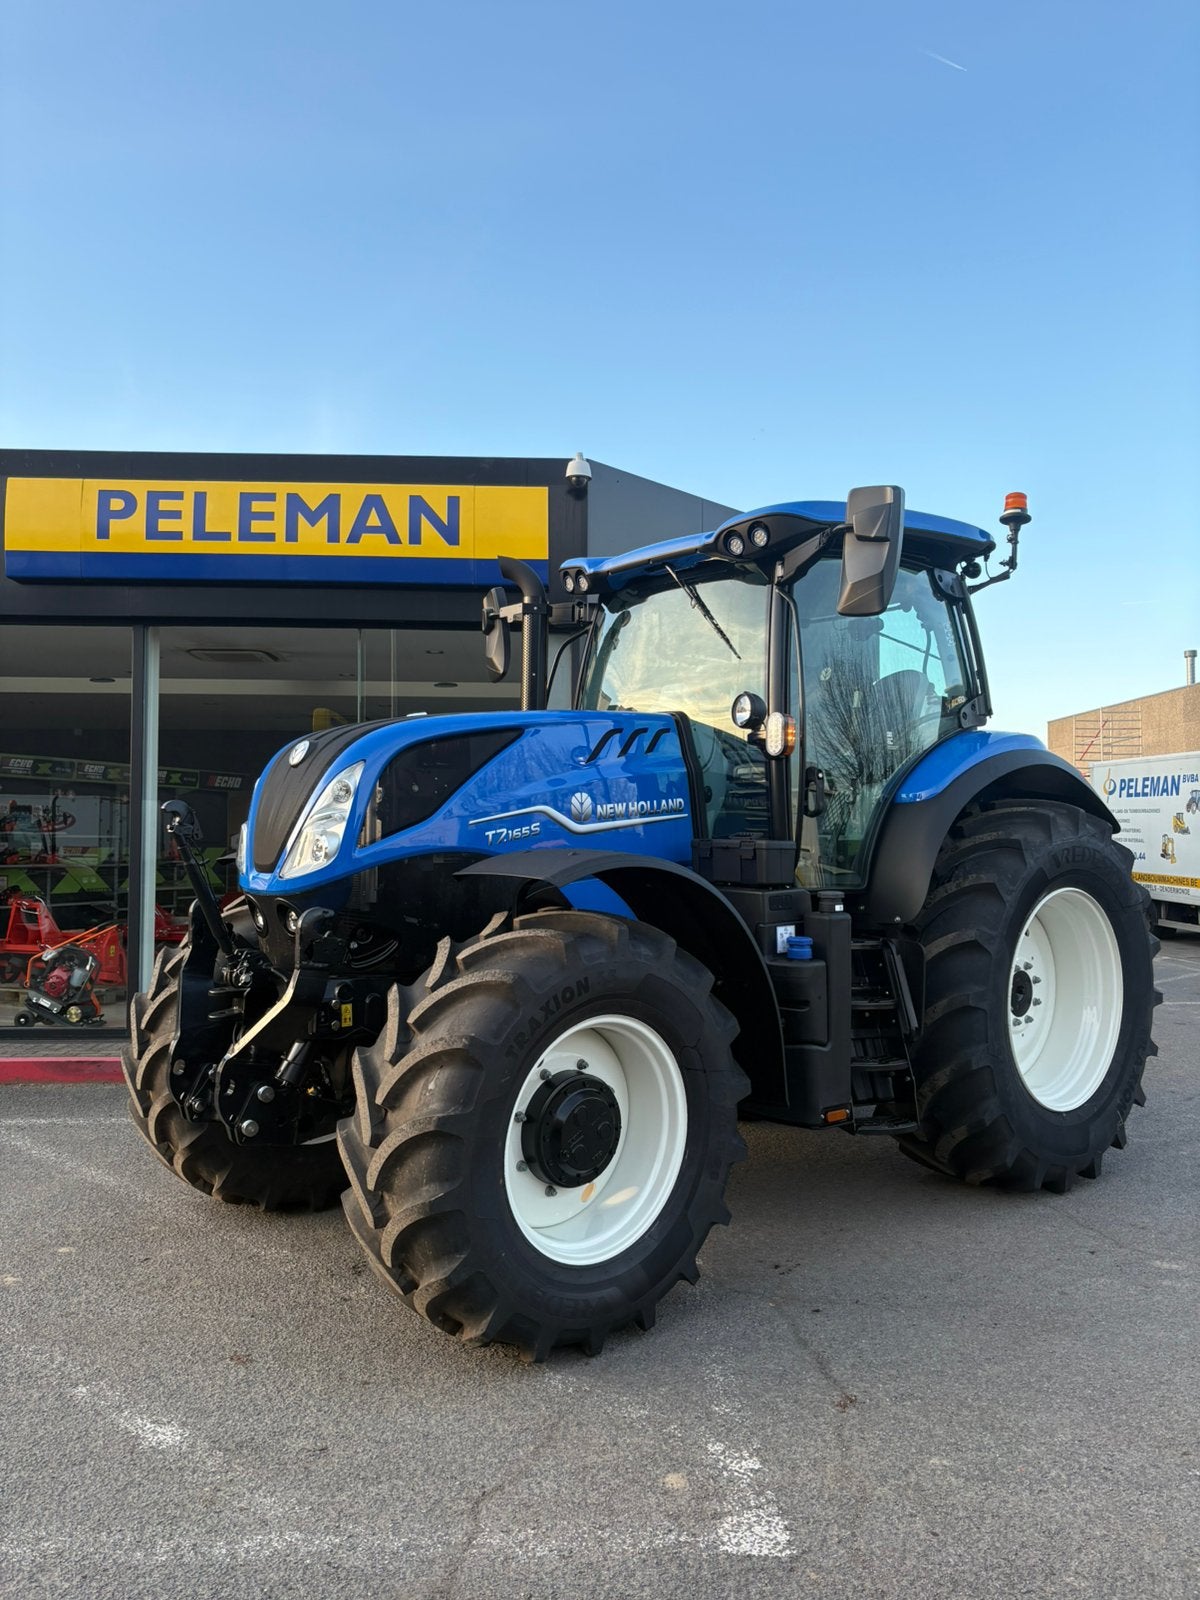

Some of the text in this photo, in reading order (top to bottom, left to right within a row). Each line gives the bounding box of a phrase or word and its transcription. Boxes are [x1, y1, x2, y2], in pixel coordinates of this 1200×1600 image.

[96, 488, 461, 546] PELEMAN
[9, 758, 34, 768] ECHO
[214, 775, 243, 788] ECHO
[1119, 773, 1199, 798] PELEMAN BVBA
[597, 798, 685, 819] NEW HOLLAND
[505, 976, 592, 1058] TRAXION
